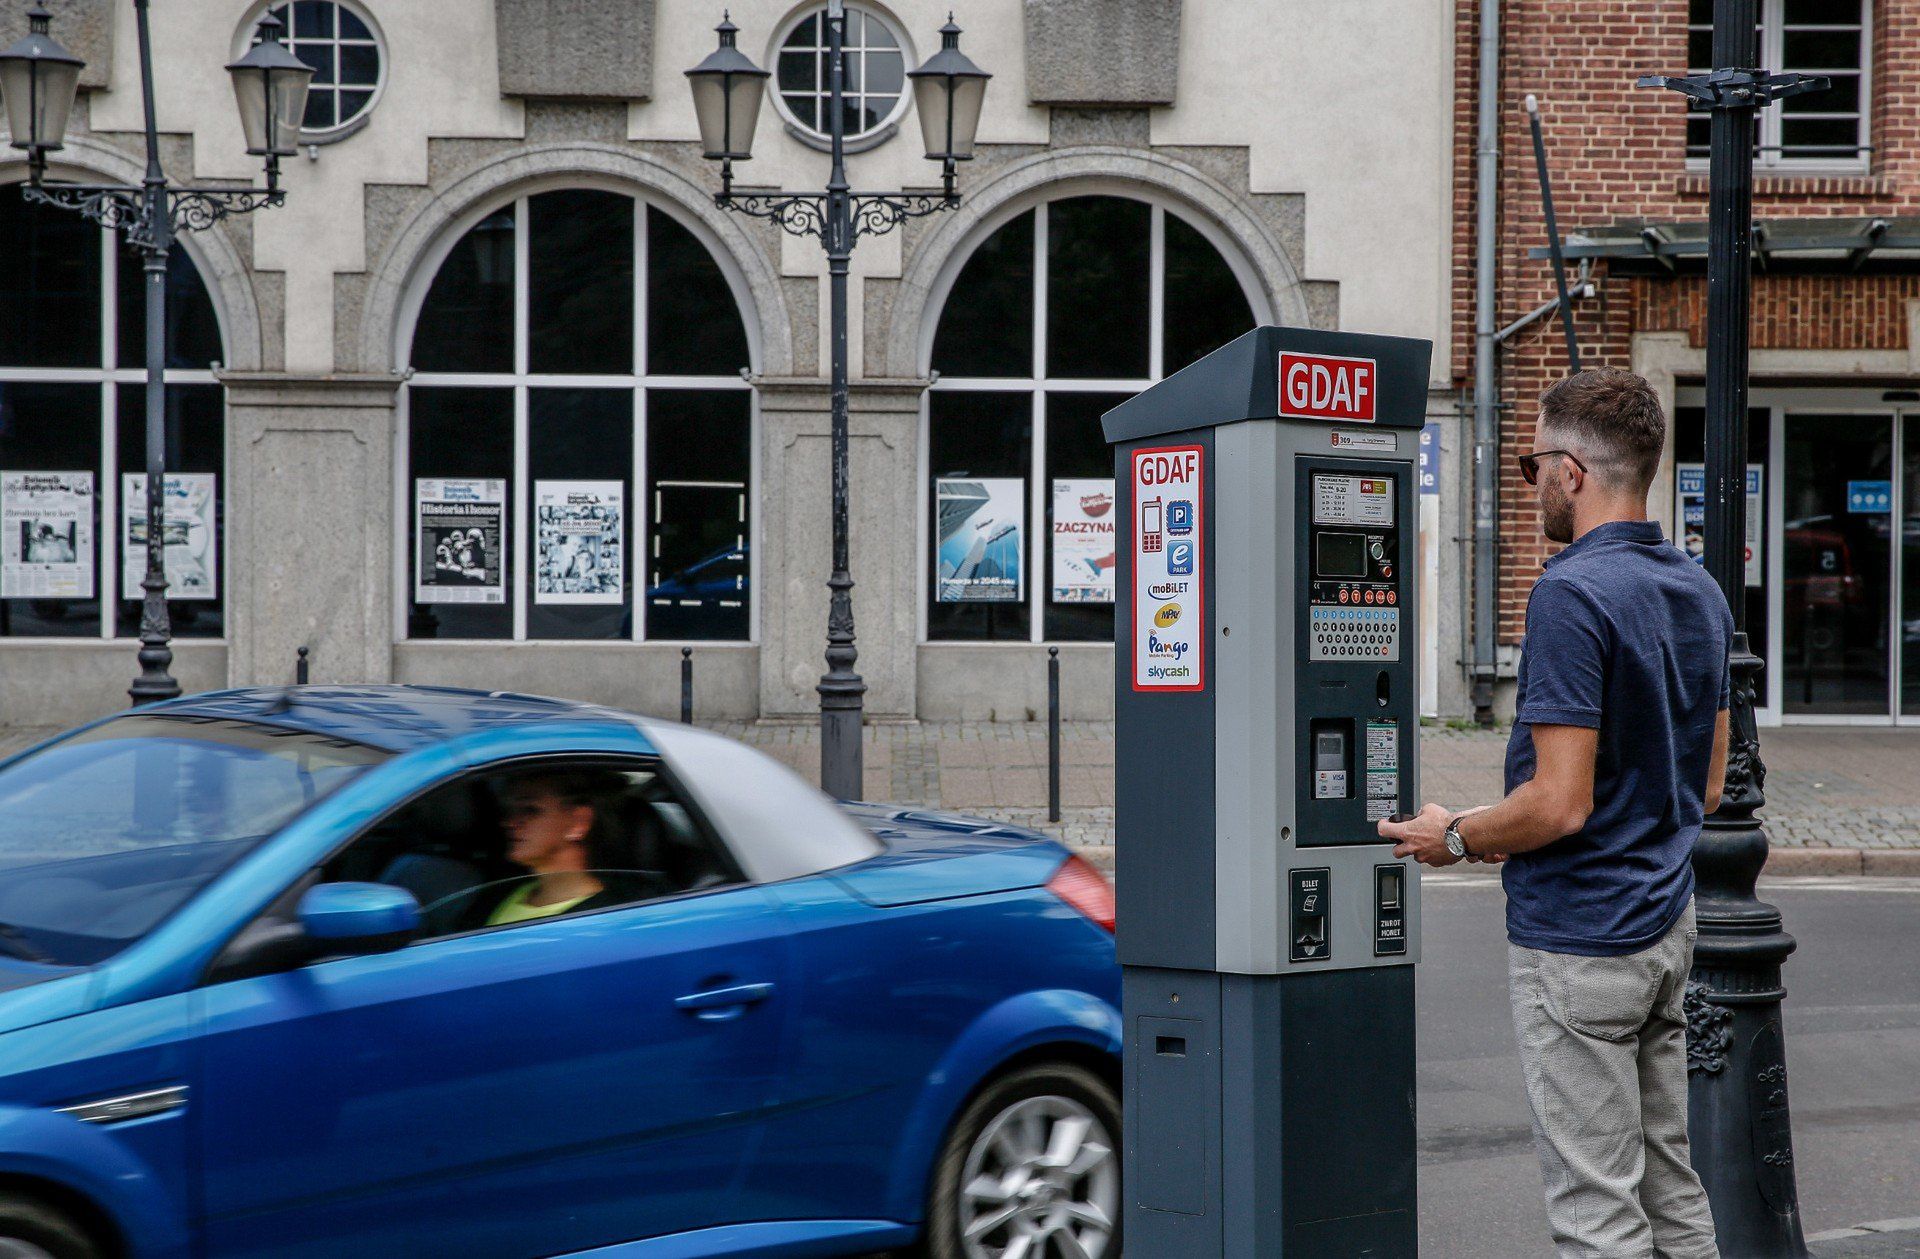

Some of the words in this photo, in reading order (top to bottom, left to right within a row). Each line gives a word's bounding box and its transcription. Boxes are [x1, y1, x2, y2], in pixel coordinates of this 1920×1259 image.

[1287, 362, 1368, 412] GDAF
[1140, 455, 1195, 486] GDAF
[422, 504, 464, 515] Historia
[465, 504, 469, 515] i
[470, 504, 500, 515] honor
[1175, 508, 1184, 523] P
[1054, 522, 1115, 534] ZACZYNA
[1172, 544, 1189, 566] e
[1152, 582, 1189, 594] moBiLET
[1149, 635, 1188, 660] Pango
[1148, 665, 1190, 679] skycash
[1302, 880, 1319, 888] BILET
[1380, 919, 1401, 928] ZWROT
